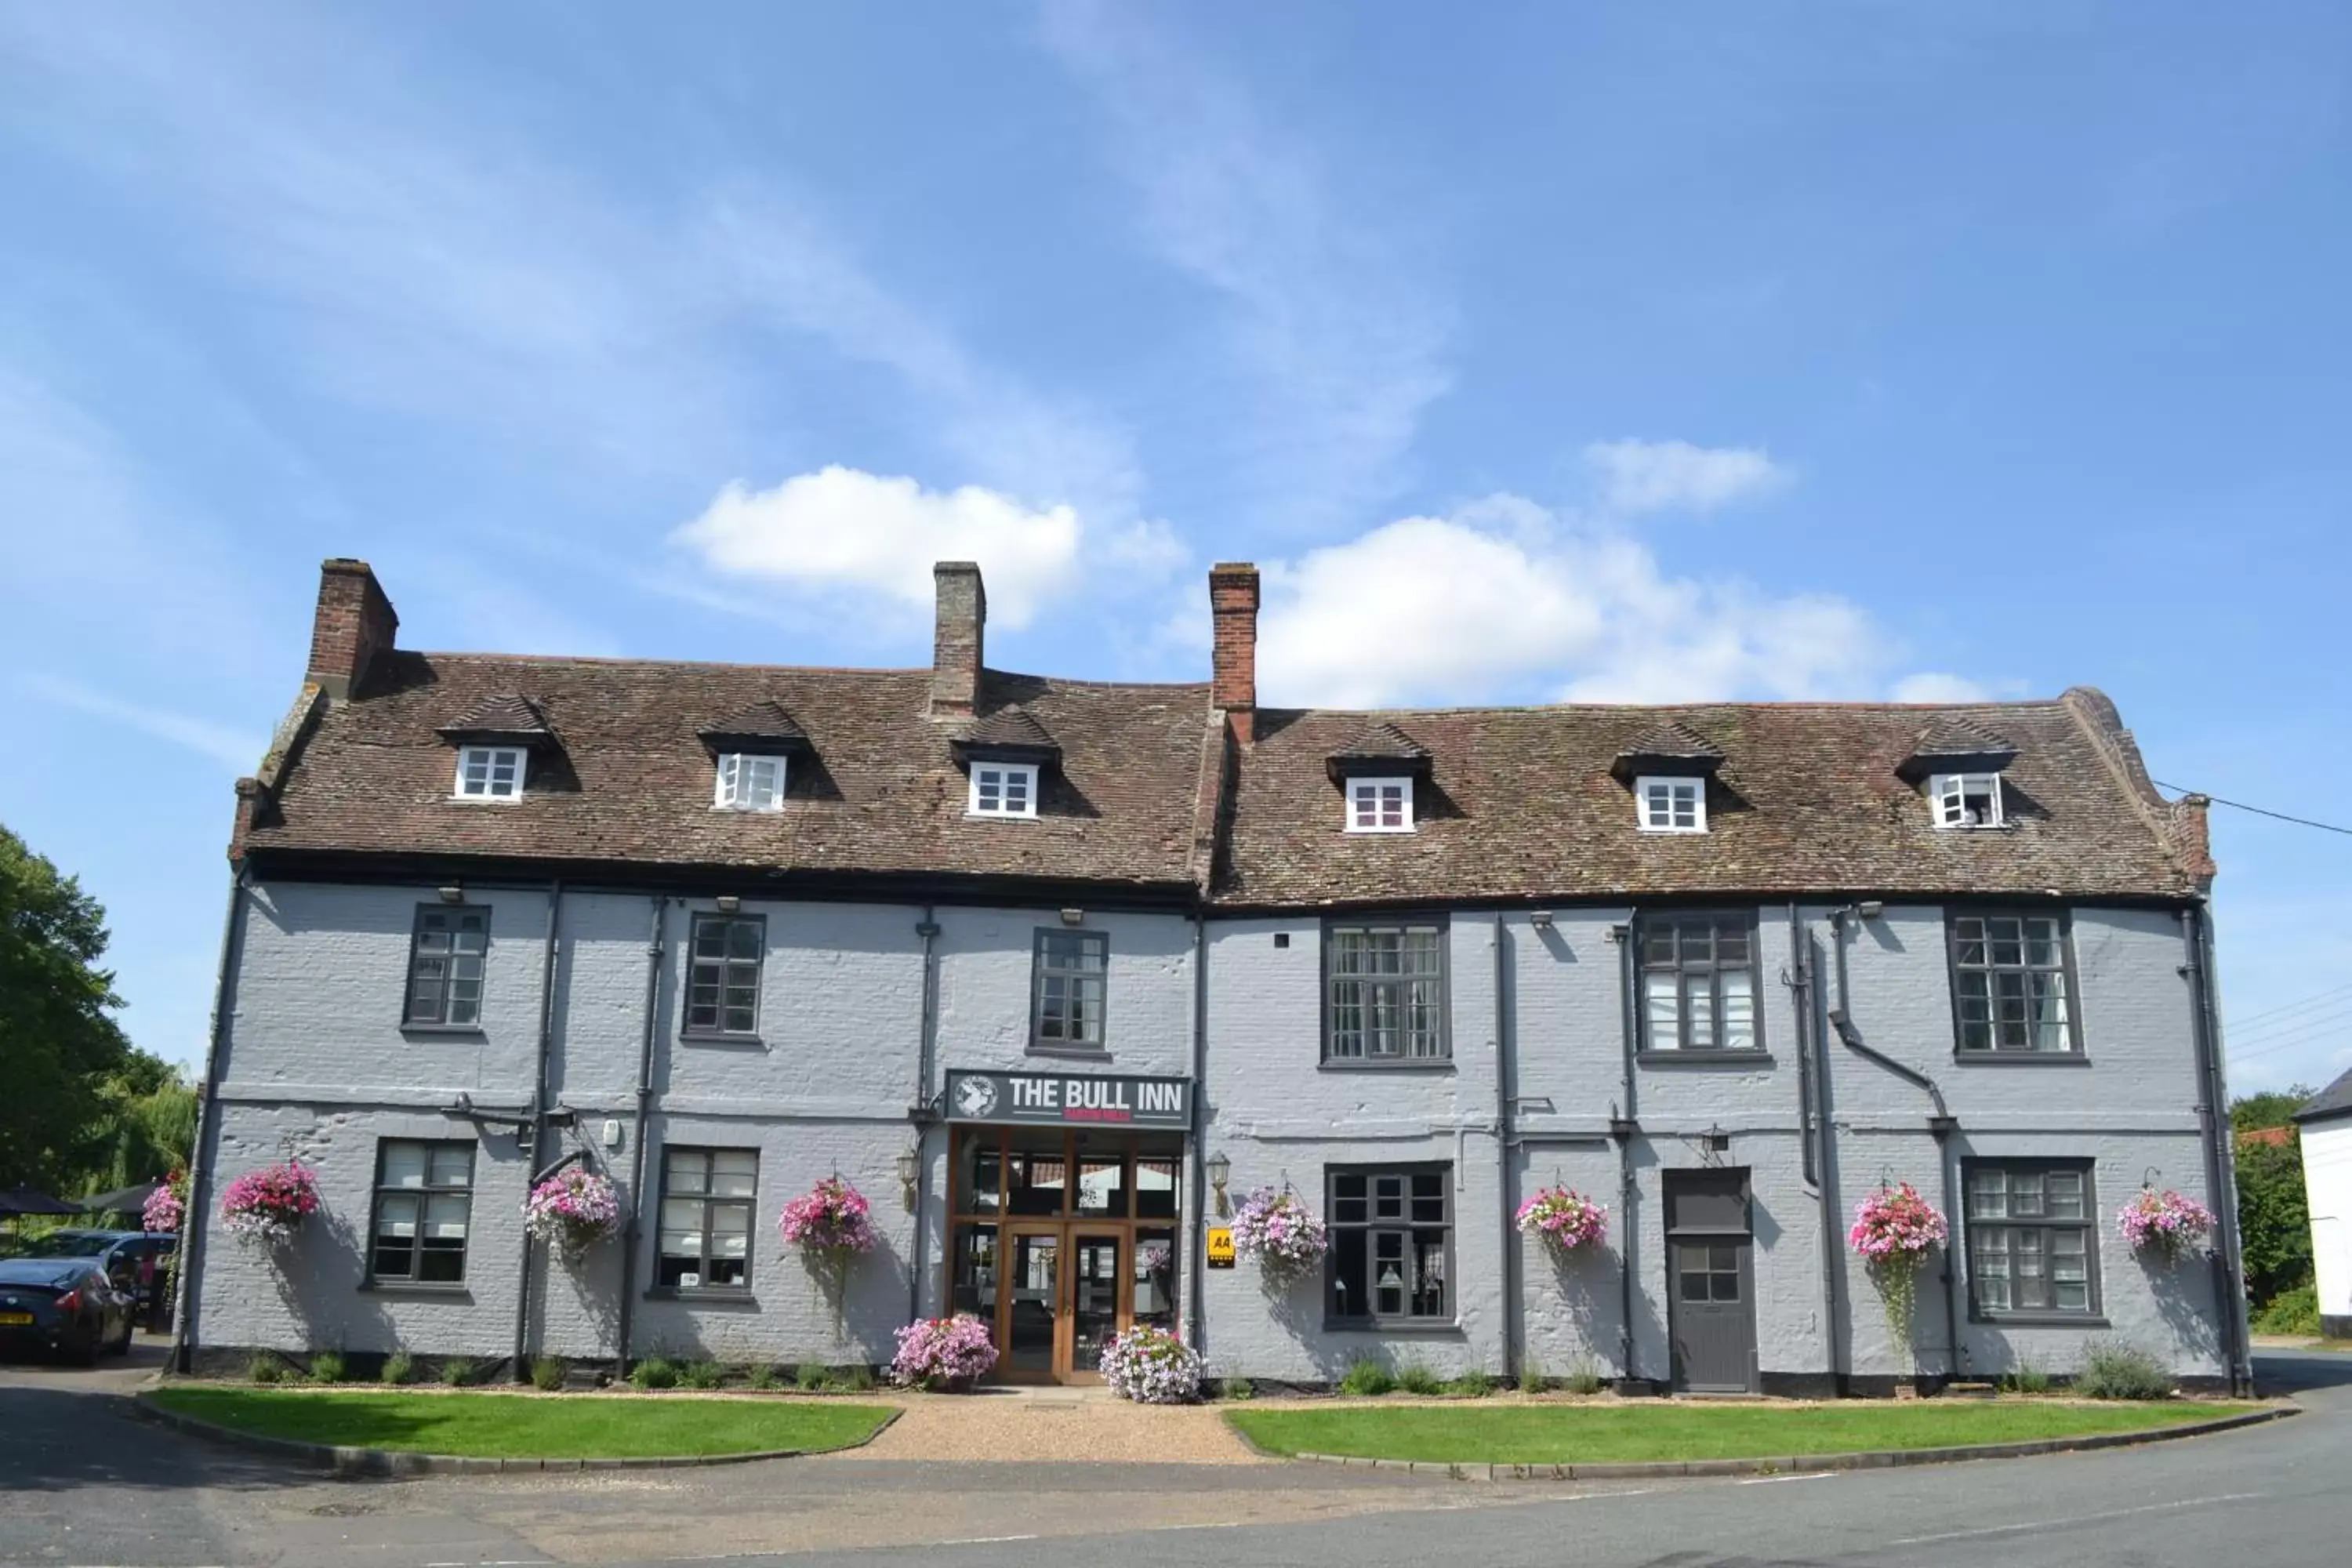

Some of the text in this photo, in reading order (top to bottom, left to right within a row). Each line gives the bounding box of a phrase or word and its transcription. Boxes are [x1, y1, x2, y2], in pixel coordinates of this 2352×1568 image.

[1010, 1078, 1181, 1111] THE BULL INN
[1214, 1236, 1229, 1248] AA
